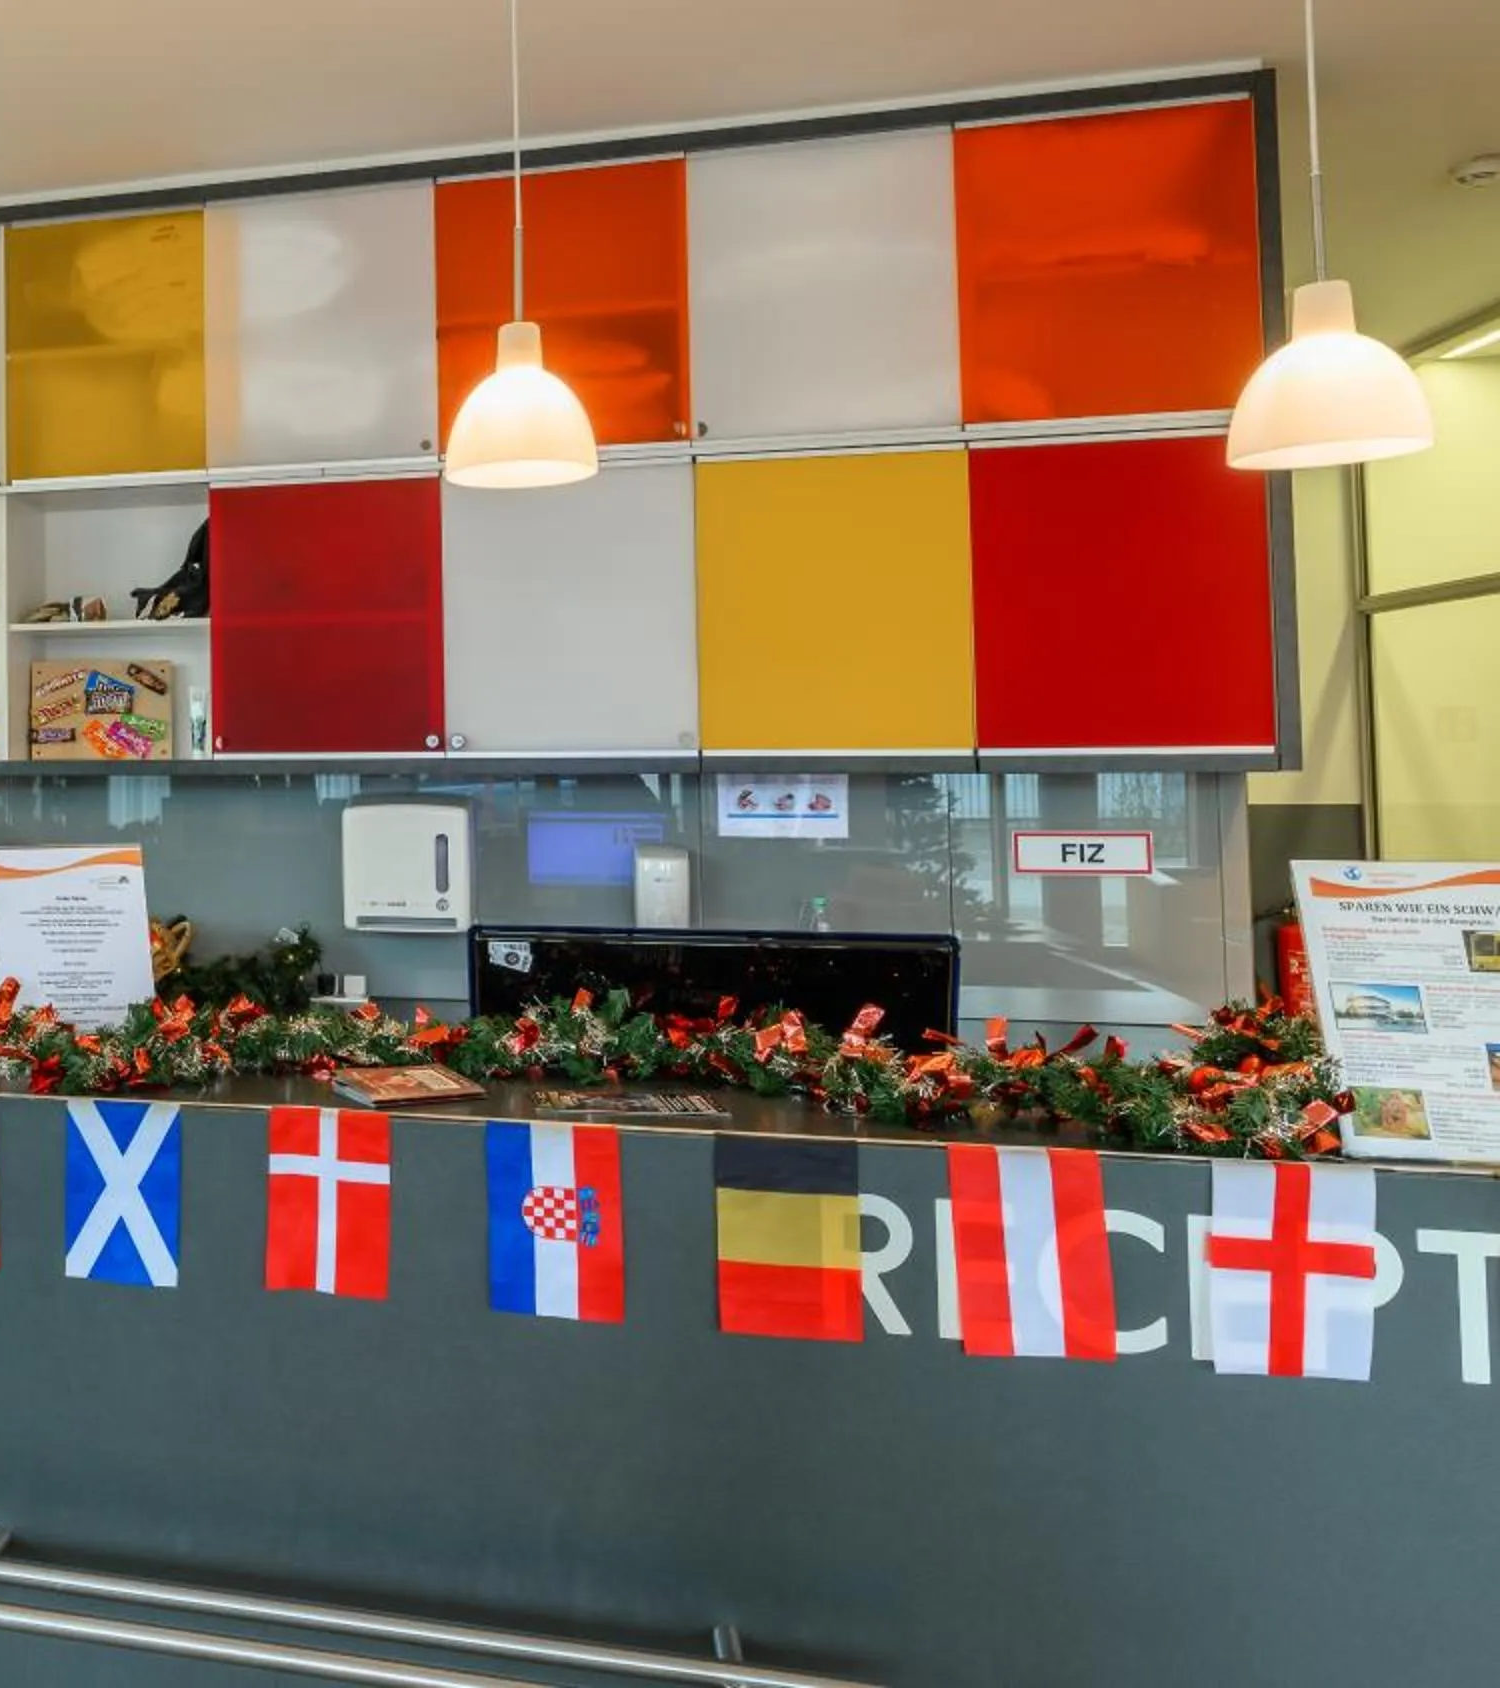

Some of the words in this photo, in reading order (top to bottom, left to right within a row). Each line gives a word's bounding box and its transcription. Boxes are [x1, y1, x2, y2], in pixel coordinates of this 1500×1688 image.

[1061, 843, 1105, 863] FIZ
[1395, 903, 1425, 914] WIE
[1427, 903, 1451, 915] EIN
